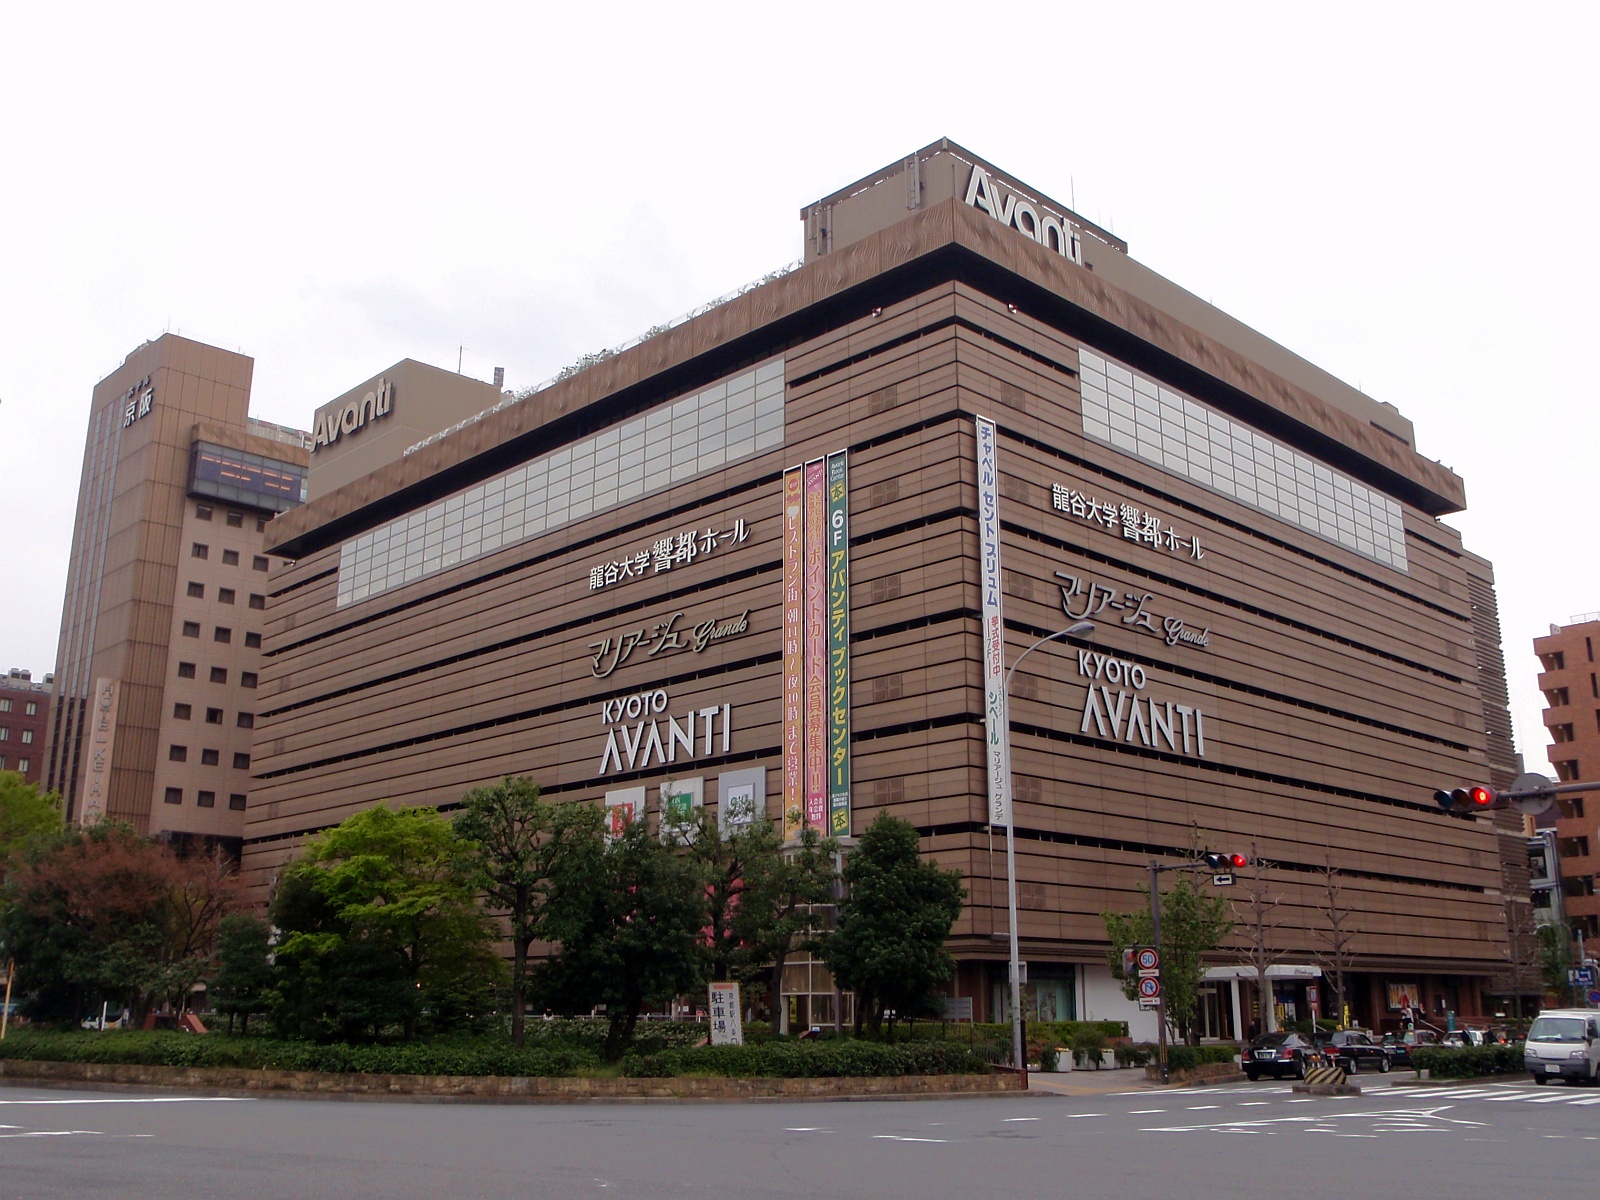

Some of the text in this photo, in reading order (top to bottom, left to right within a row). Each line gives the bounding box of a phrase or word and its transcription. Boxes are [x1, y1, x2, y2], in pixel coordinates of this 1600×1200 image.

[965, 165, 1082, 266] Avanti
[123, 387, 153, 428] 京阪
[310, 378, 392, 453] Avanti
[981, 427, 993, 487] チャペル
[831, 485, 843, 499] 本
[832, 510, 844, 546] 6F
[831, 550, 846, 641] アバンティ
[1054, 571, 1210, 647] マリアージュ Grande
[588, 609, 750, 679] マリアージュ Grande
[1078, 649, 1146, 690] KYOTO
[599, 703, 733, 775] AVANTI
[602, 689, 668, 725] KYOTO
[833, 646, 847, 785] ブックセンター
[1080, 682, 1204, 756] AVANTI
[88, 685, 114, 821] HOTEL KEIHAN
[834, 813, 846, 828] 本
[1142, 955, 1154, 964] 50
[711, 991, 726, 1034] 駐車場
